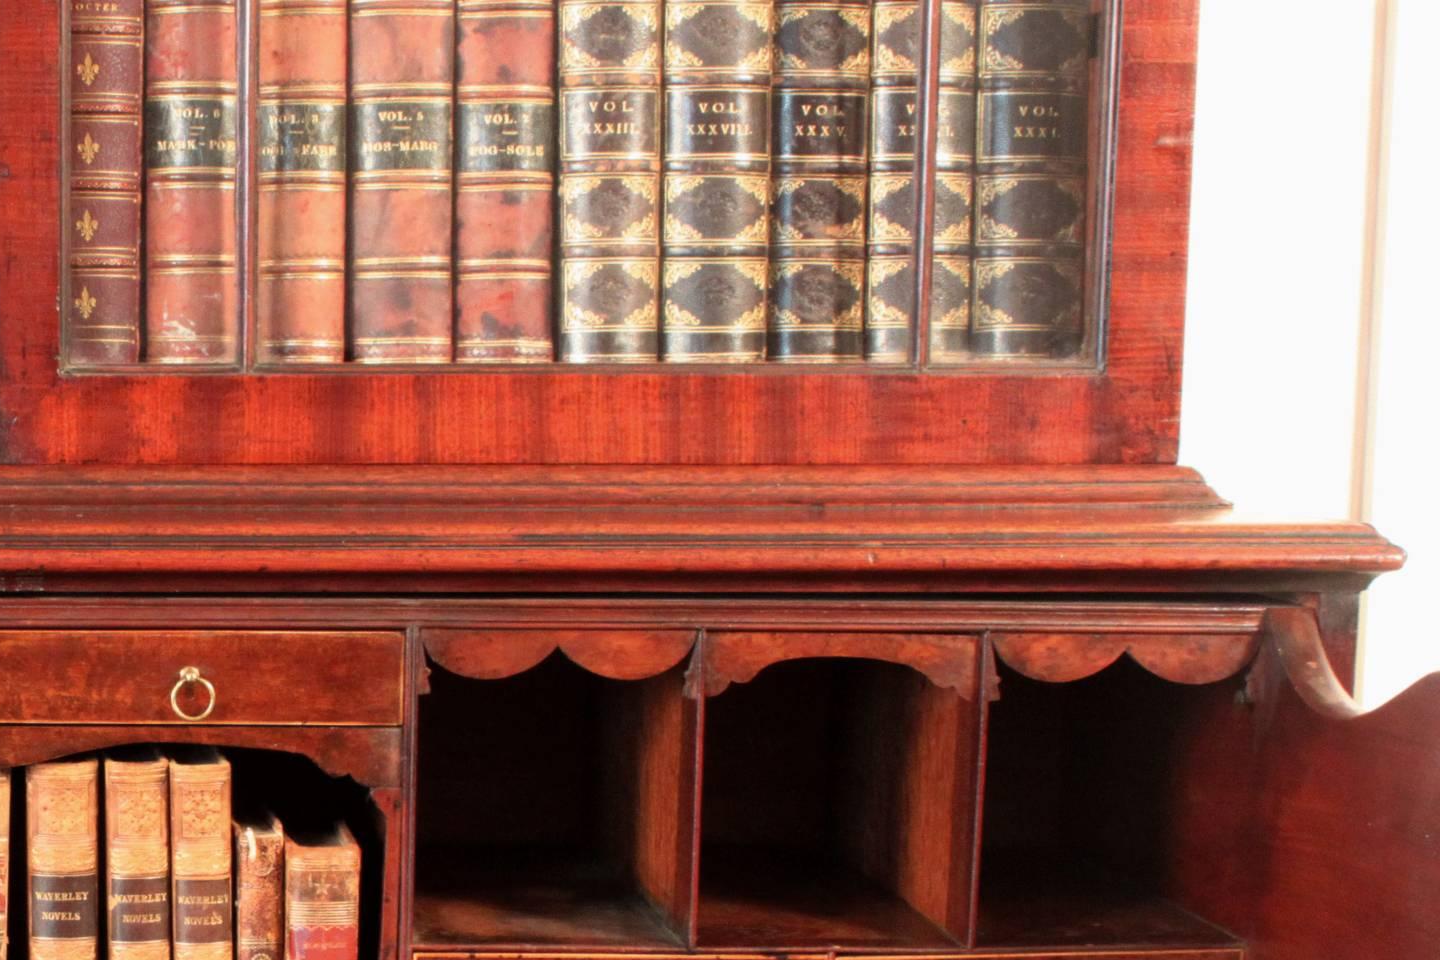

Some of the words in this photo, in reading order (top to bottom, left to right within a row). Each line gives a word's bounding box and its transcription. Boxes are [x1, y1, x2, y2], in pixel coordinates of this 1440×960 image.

[378, 111, 412, 121] VOL.
[484, 114, 518, 124] VOL.
[35, 890, 89, 901] WAVERLEY
[114, 892, 168, 904] WAVERLEY
[41, 911, 81, 921] NOVELS
[122, 913, 161, 924] NOVELS
[183, 915, 223, 925] NOVELS
